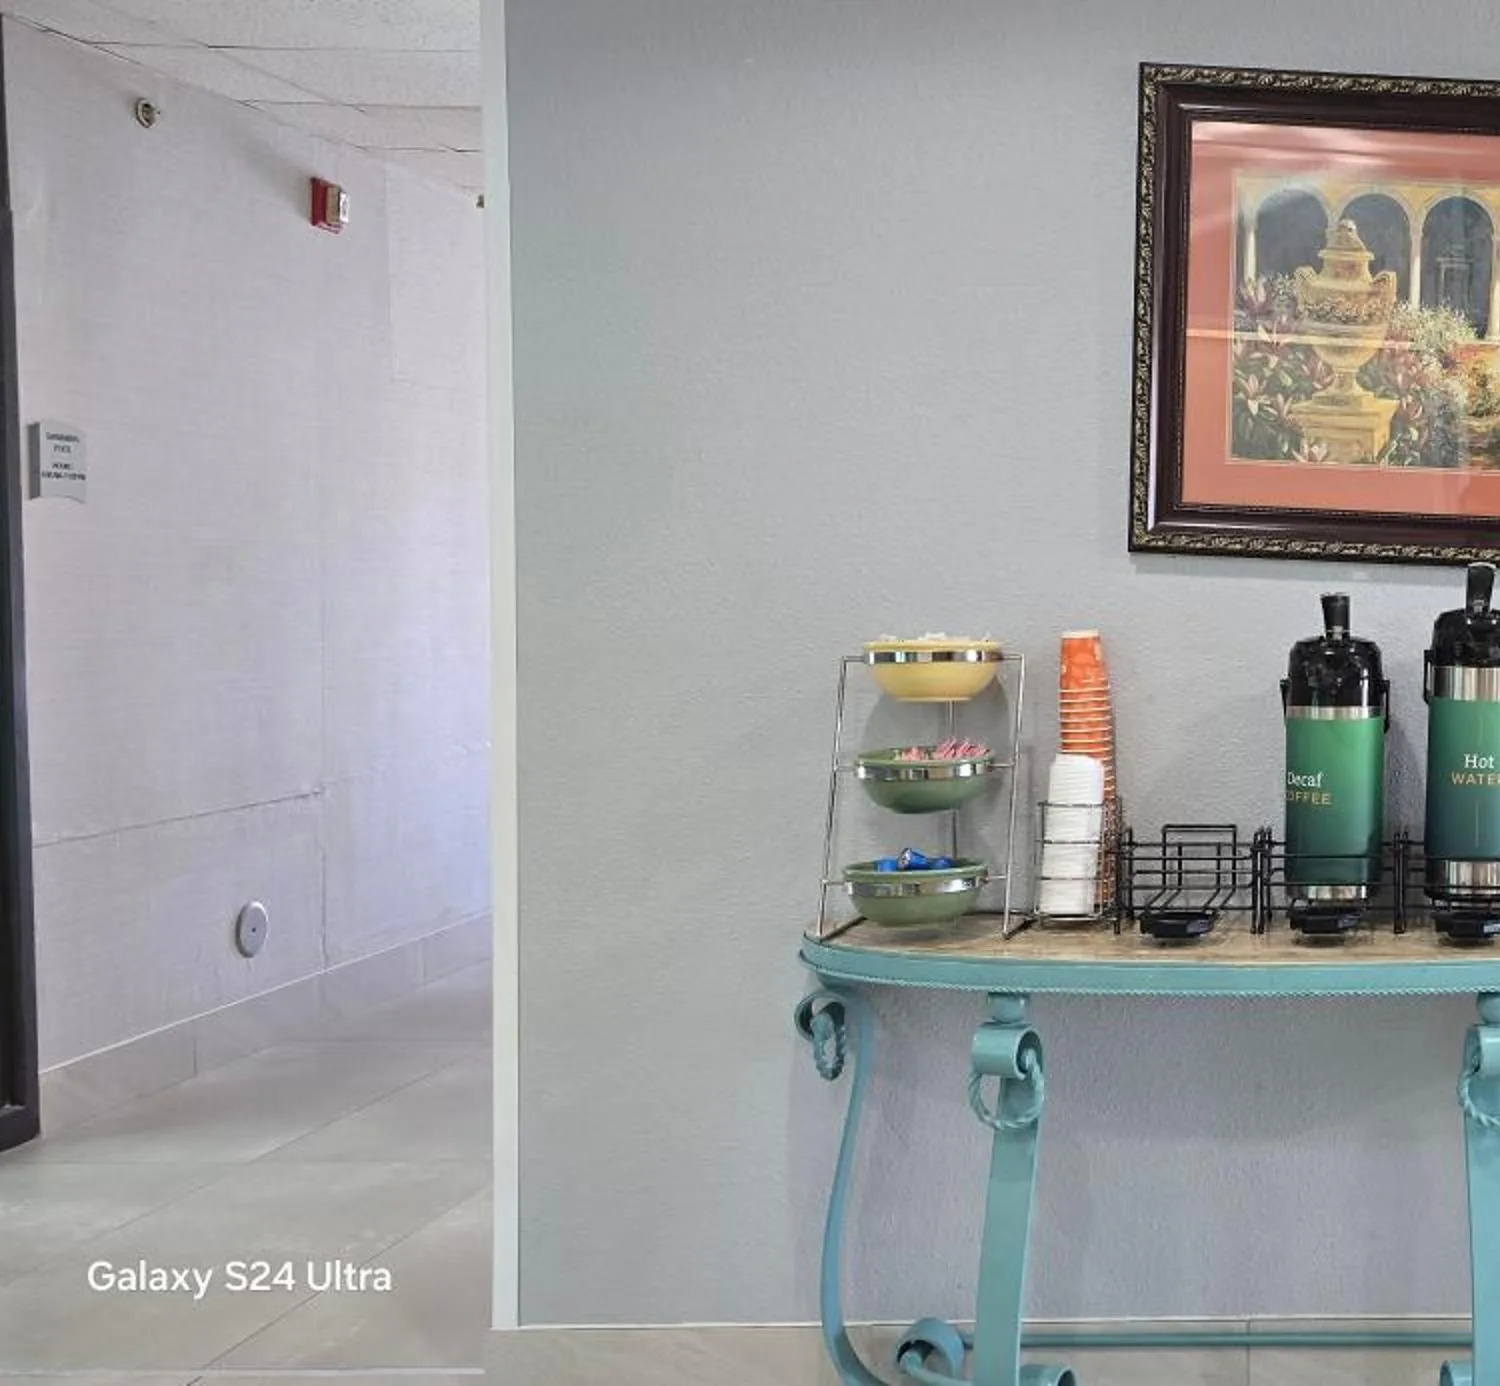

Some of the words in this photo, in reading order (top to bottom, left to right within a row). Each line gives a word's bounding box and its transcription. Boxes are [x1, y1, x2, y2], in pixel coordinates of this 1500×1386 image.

[1463, 753, 1495, 769] Hot
[1287, 771, 1325, 788] Decaf
[1286, 791, 1332, 805] OFFEE
